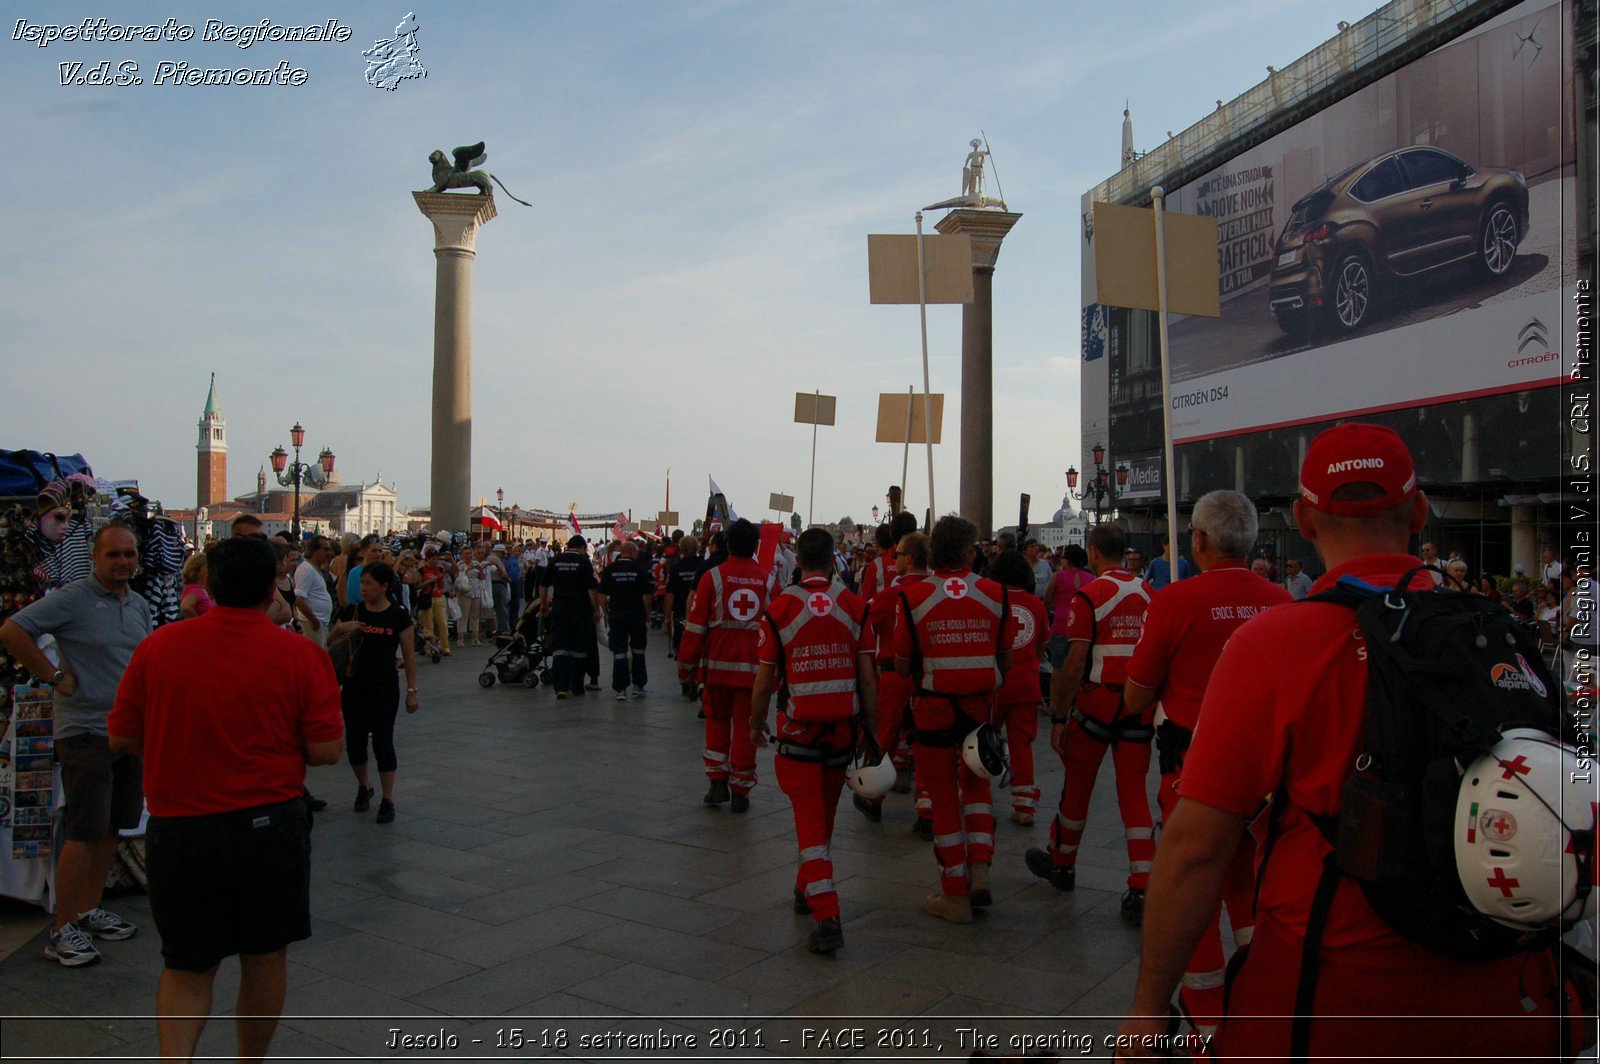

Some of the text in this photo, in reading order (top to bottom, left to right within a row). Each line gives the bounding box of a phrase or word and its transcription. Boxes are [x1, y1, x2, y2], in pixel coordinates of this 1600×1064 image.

[1222, 173, 1237, 190] UNA
[1237, 166, 1262, 186] STRADA
[1212, 186, 1262, 217] DOVE NON
[1223, 267, 1253, 292] LA TUA
[1172, 385, 1229, 410] CITROËN DS4
[1327, 458, 1384, 474] ANTONIO
[1211, 606, 1235, 620] CROCE
[926, 620, 946, 632] CROCE
[947, 619, 966, 631] ROSSA
[811, 643, 830, 656] ROSSA
[1498, 679, 1529, 691] alpine
